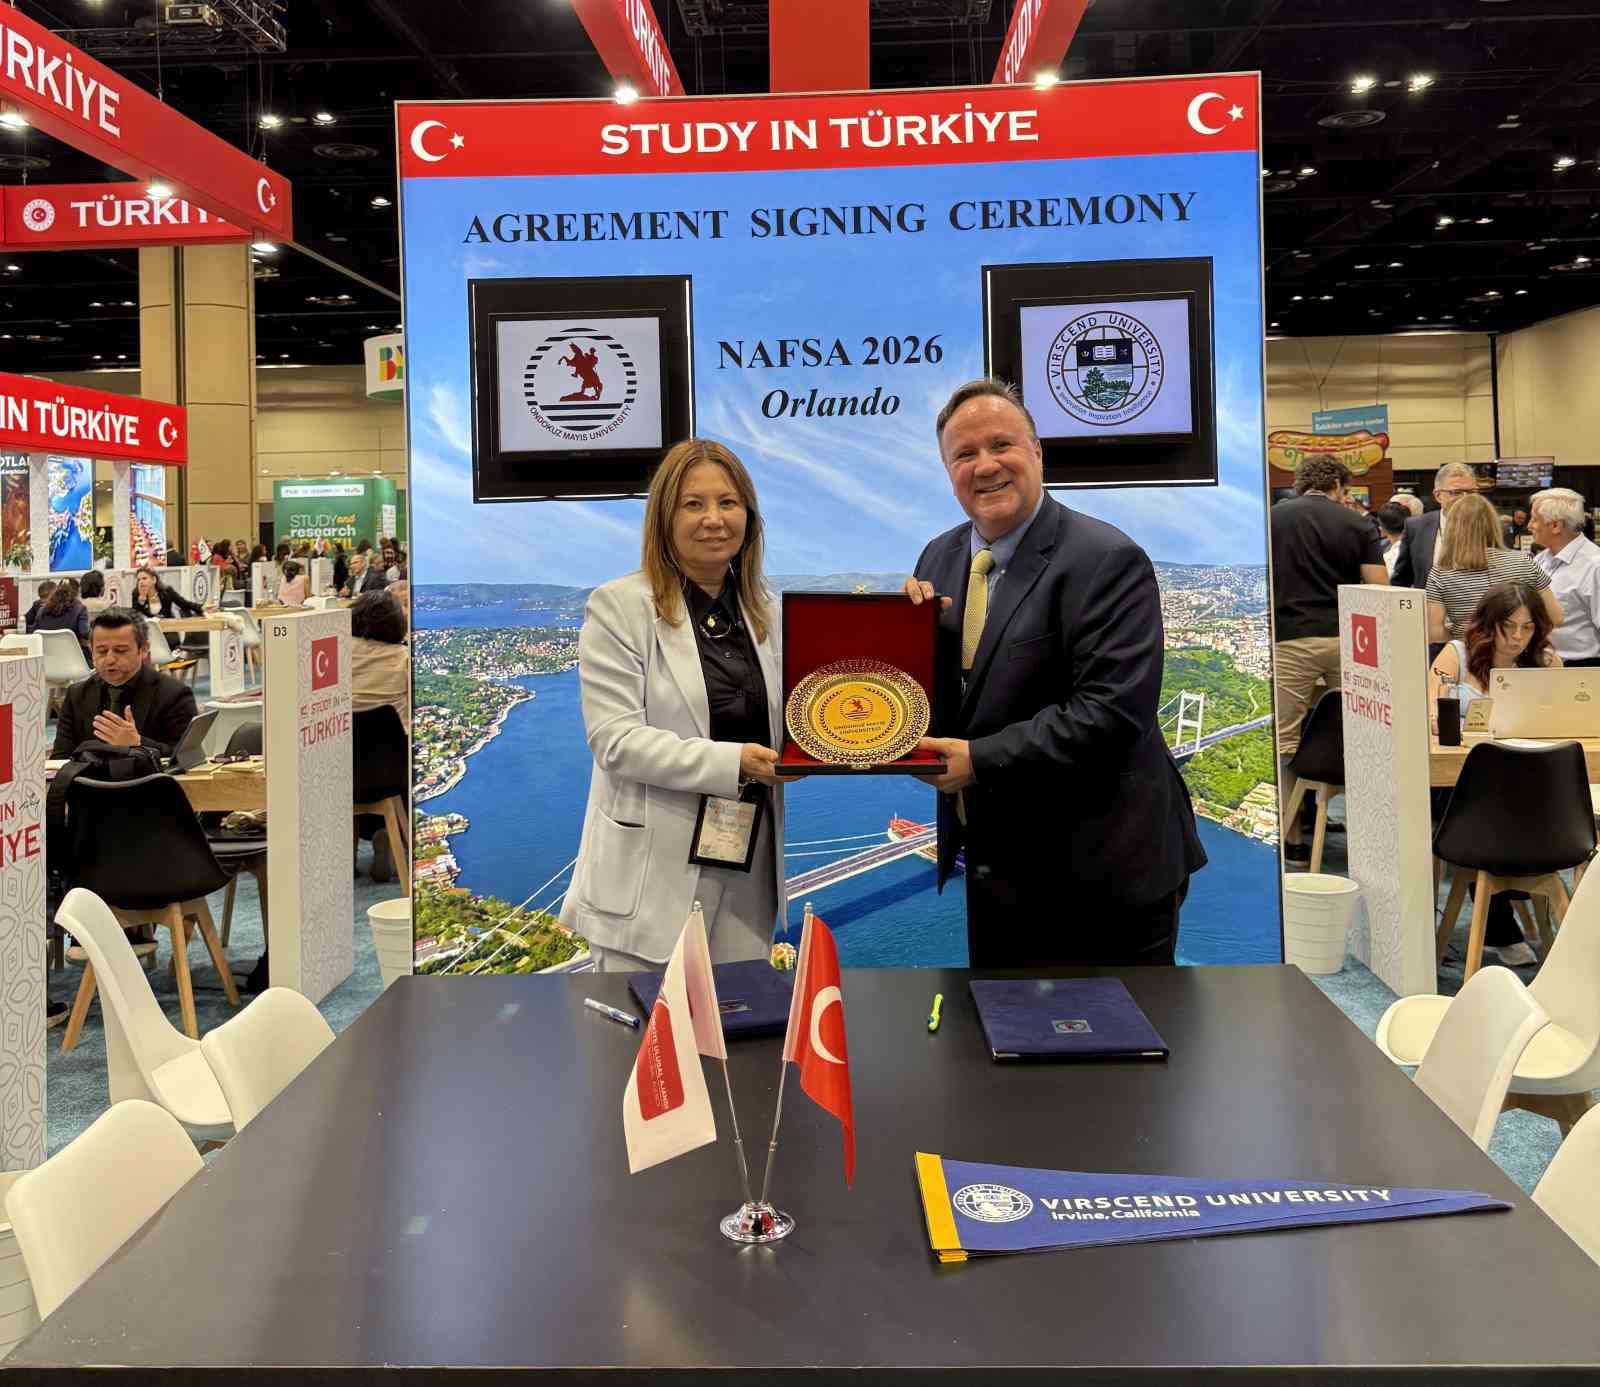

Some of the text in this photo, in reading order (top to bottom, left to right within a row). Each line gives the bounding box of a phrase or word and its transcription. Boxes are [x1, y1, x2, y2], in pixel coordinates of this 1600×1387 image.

[601, 103, 1039, 155] STUDY IN TÜRKİYE
[463, 192, 1196, 243] AGREEMENT SIGNING CEREMONY
[719, 334, 943, 369] NAFSA 2026
[1051, 314, 1161, 378] VIRSCEND UNIVERSITY
[761, 386, 901, 419] Orlando
[0, 395, 139, 446] IN TÜRKİYE
[530, 405, 632, 441] ONDOKUZ MAYIS UNIVERSITY
[290, 514, 336, 528] STUDY
[290, 524, 356, 538] research
[1399, 600, 1412, 610] F3
[274, 626, 287, 637] D3
[1344, 688, 1392, 727] TÜRKİYE
[300, 711, 350, 748] TÜRKİYE
[1040, 1195, 1197, 1211] VIRSCEND
[1204, 1189, 1392, 1206] UNIVERSITY
[1052, 1209, 1200, 1221] Irvine, California
